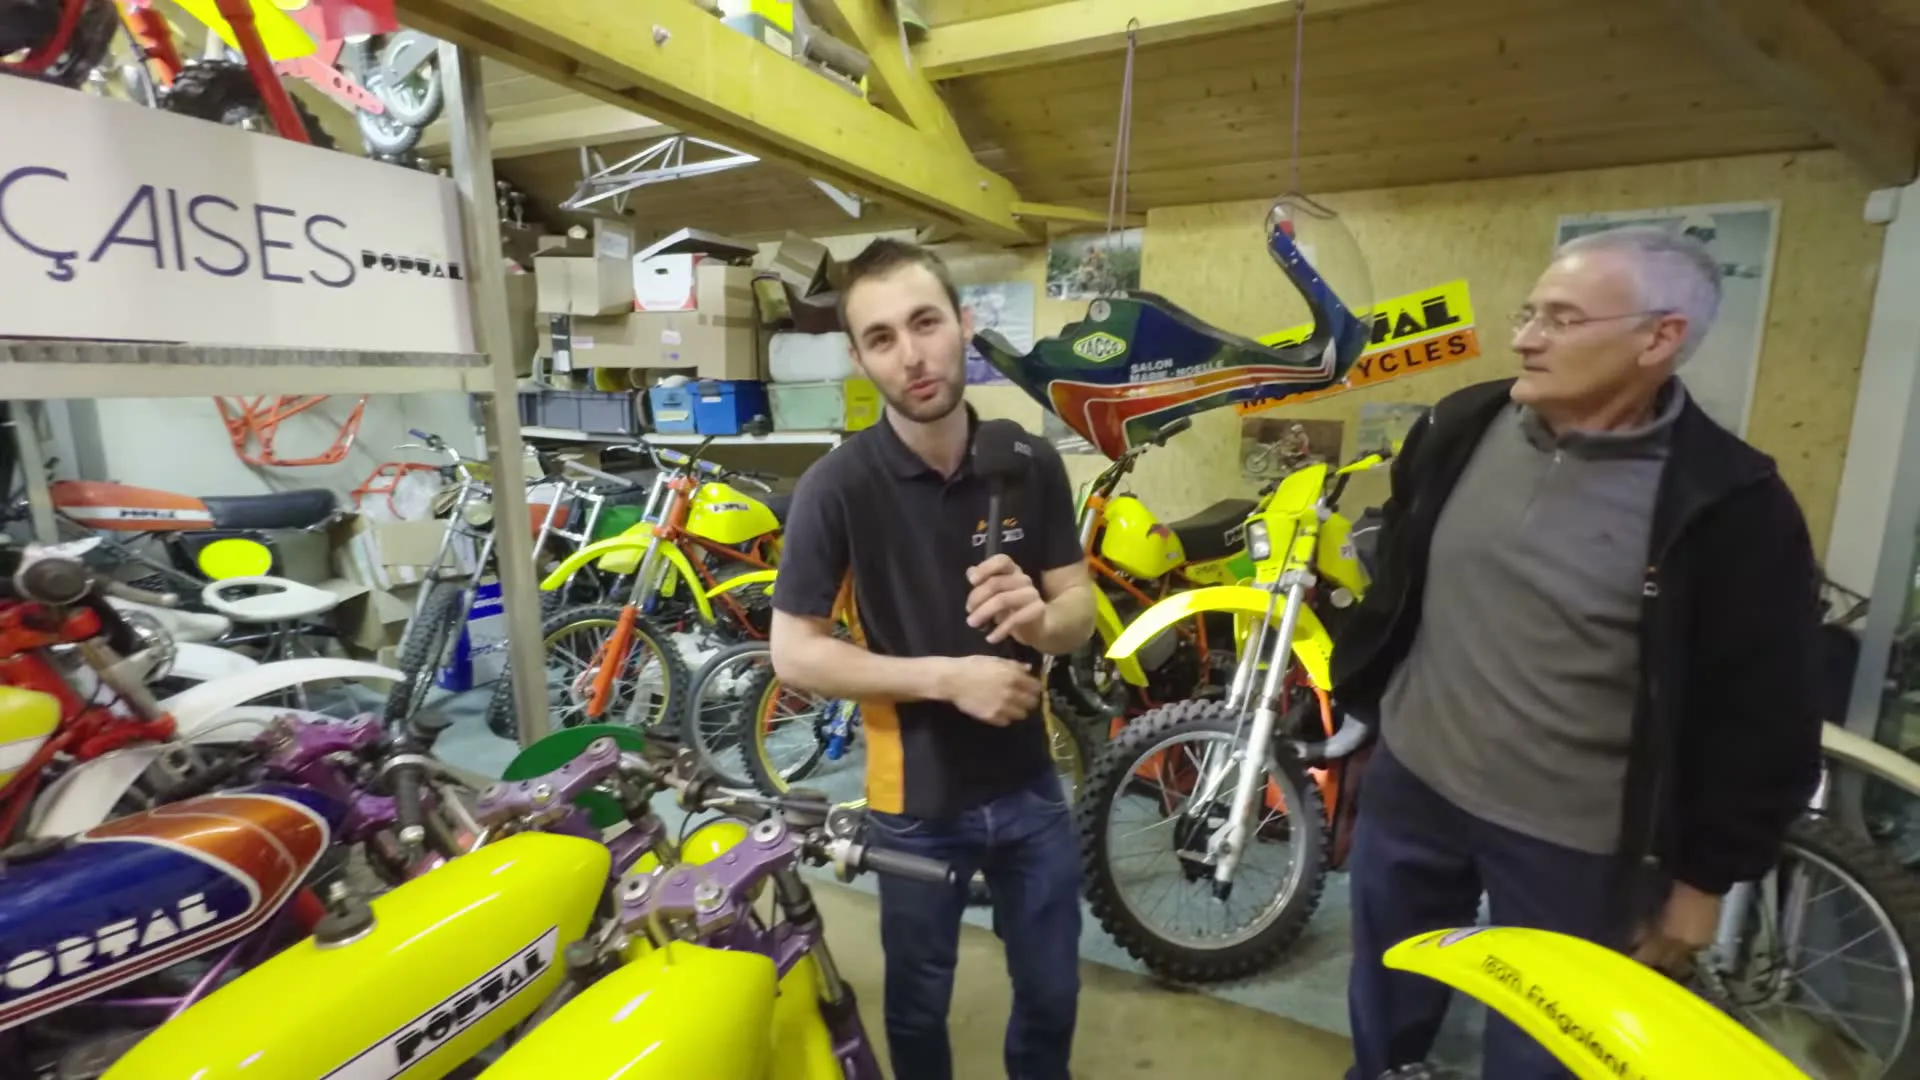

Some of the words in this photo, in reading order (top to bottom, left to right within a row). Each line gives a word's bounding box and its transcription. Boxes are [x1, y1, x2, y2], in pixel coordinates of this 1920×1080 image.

[0, 166, 356, 288] ÇAISES
[1130, 358, 1173, 374] SALON
[0, 892, 218, 989] ORTAL
[395, 947, 546, 1067] PORTAL
